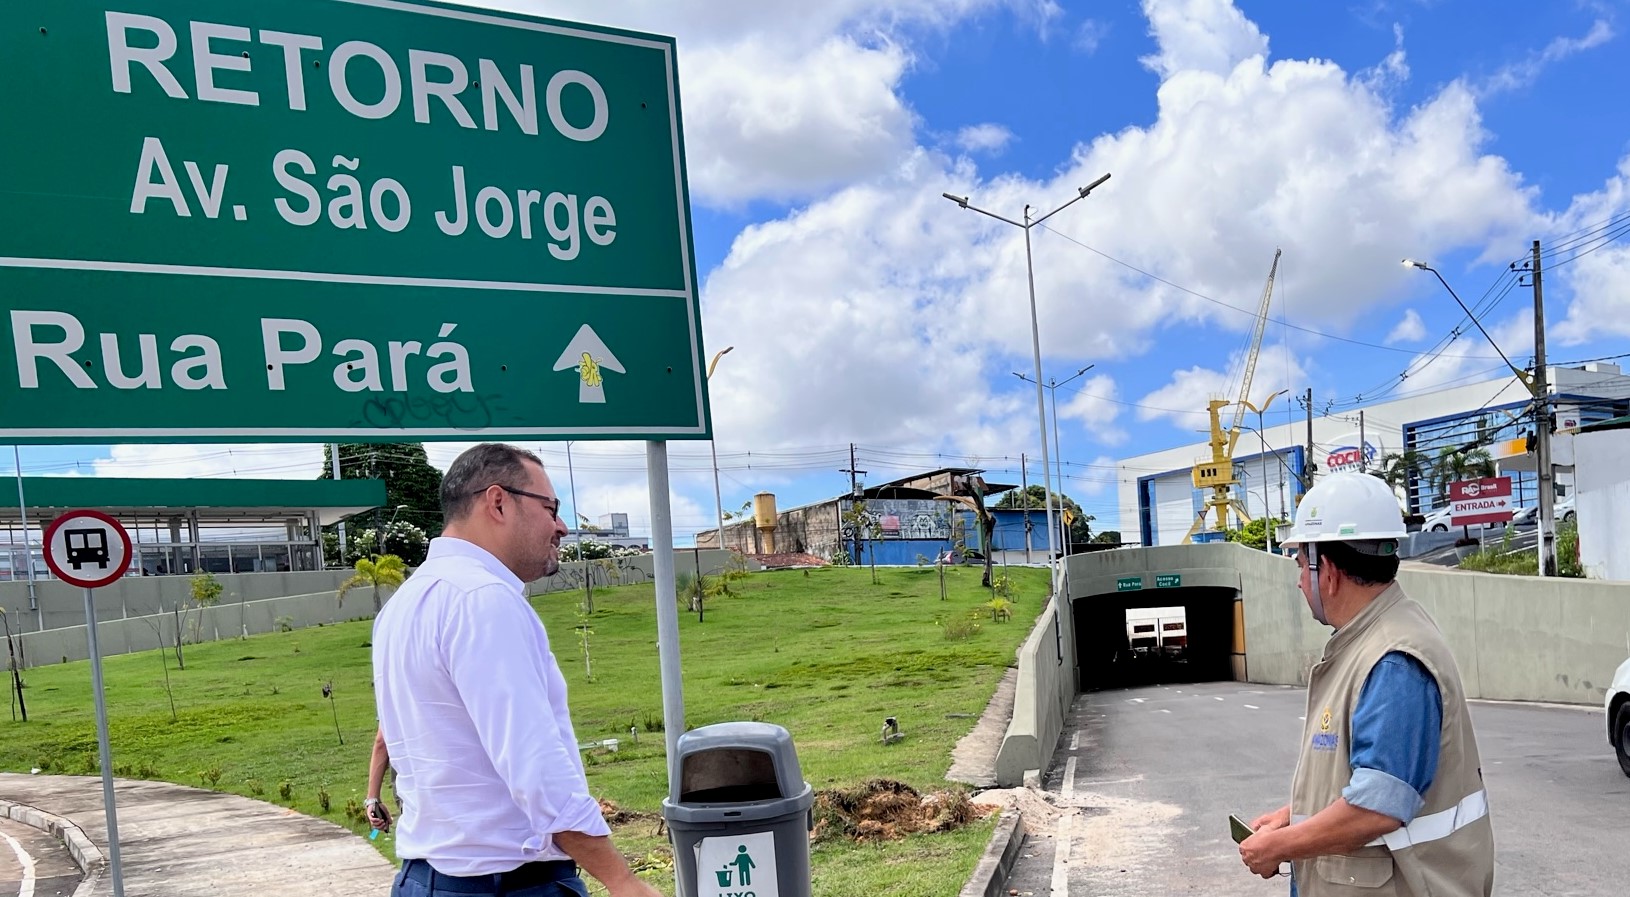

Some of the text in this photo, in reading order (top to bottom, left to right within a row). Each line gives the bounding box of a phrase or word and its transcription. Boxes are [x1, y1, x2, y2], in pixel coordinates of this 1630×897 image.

[105, 11, 610, 142] RETORNO
[130, 137, 617, 261] Av. São Jorge
[10, 310, 475, 393] Rua Pará
[1455, 501, 1495, 512] ENTRADA
[1481, 483, 1497, 491] Brasil
